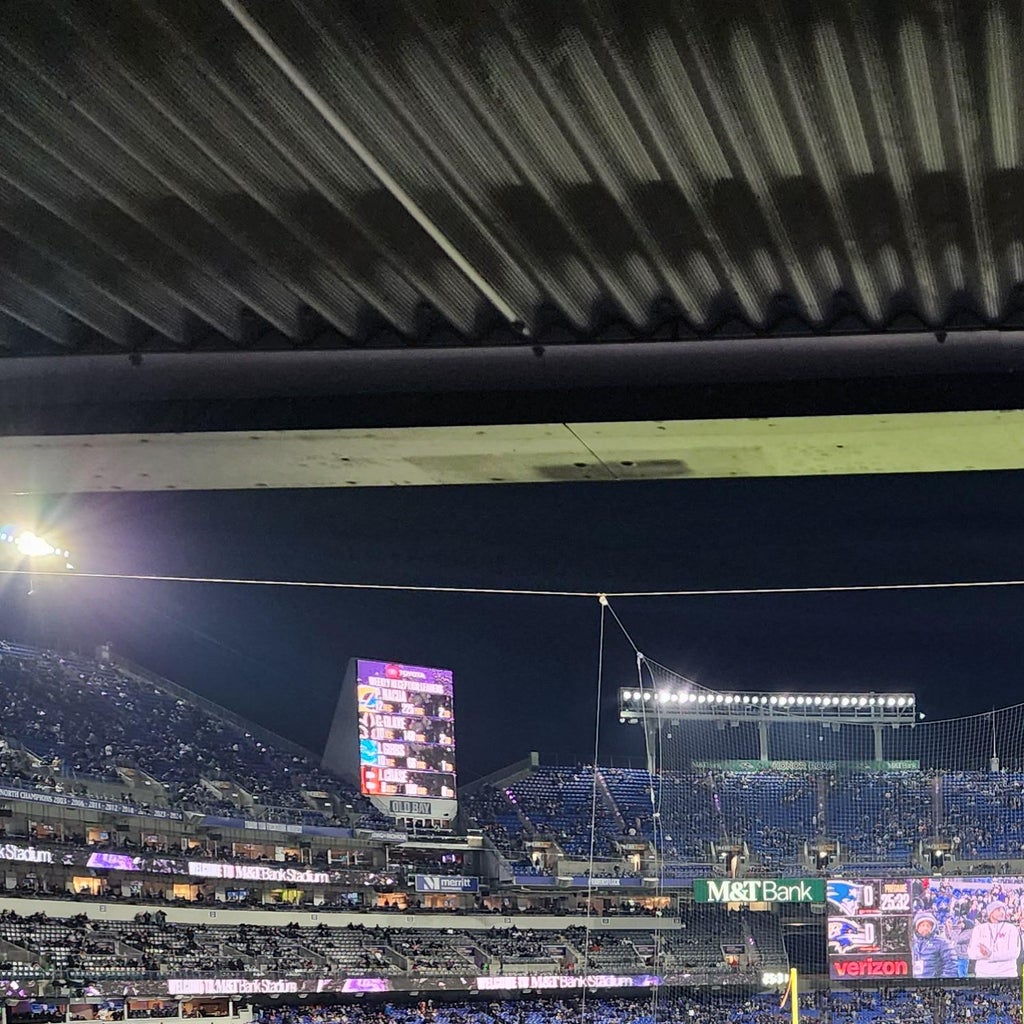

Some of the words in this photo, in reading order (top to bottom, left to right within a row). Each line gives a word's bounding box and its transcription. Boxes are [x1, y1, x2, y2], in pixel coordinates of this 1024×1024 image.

[392, 801, 411, 813] OLD
[412, 802, 430, 815] BAY
[6, 843, 51, 863] Stadium
[263, 868, 287, 882] Bank
[286, 870, 330, 884] Stadium
[441, 878, 471, 889] merritt
[707, 880, 762, 902] M&T
[763, 880, 813, 901] Bank
[863, 885, 874, 907] 0
[834, 957, 908, 976] verizon
[240, 979, 261, 993] Bank
[261, 979, 298, 993] Stadium
[560, 975, 586, 988] Bank
[585, 975, 633, 988] Stadium
